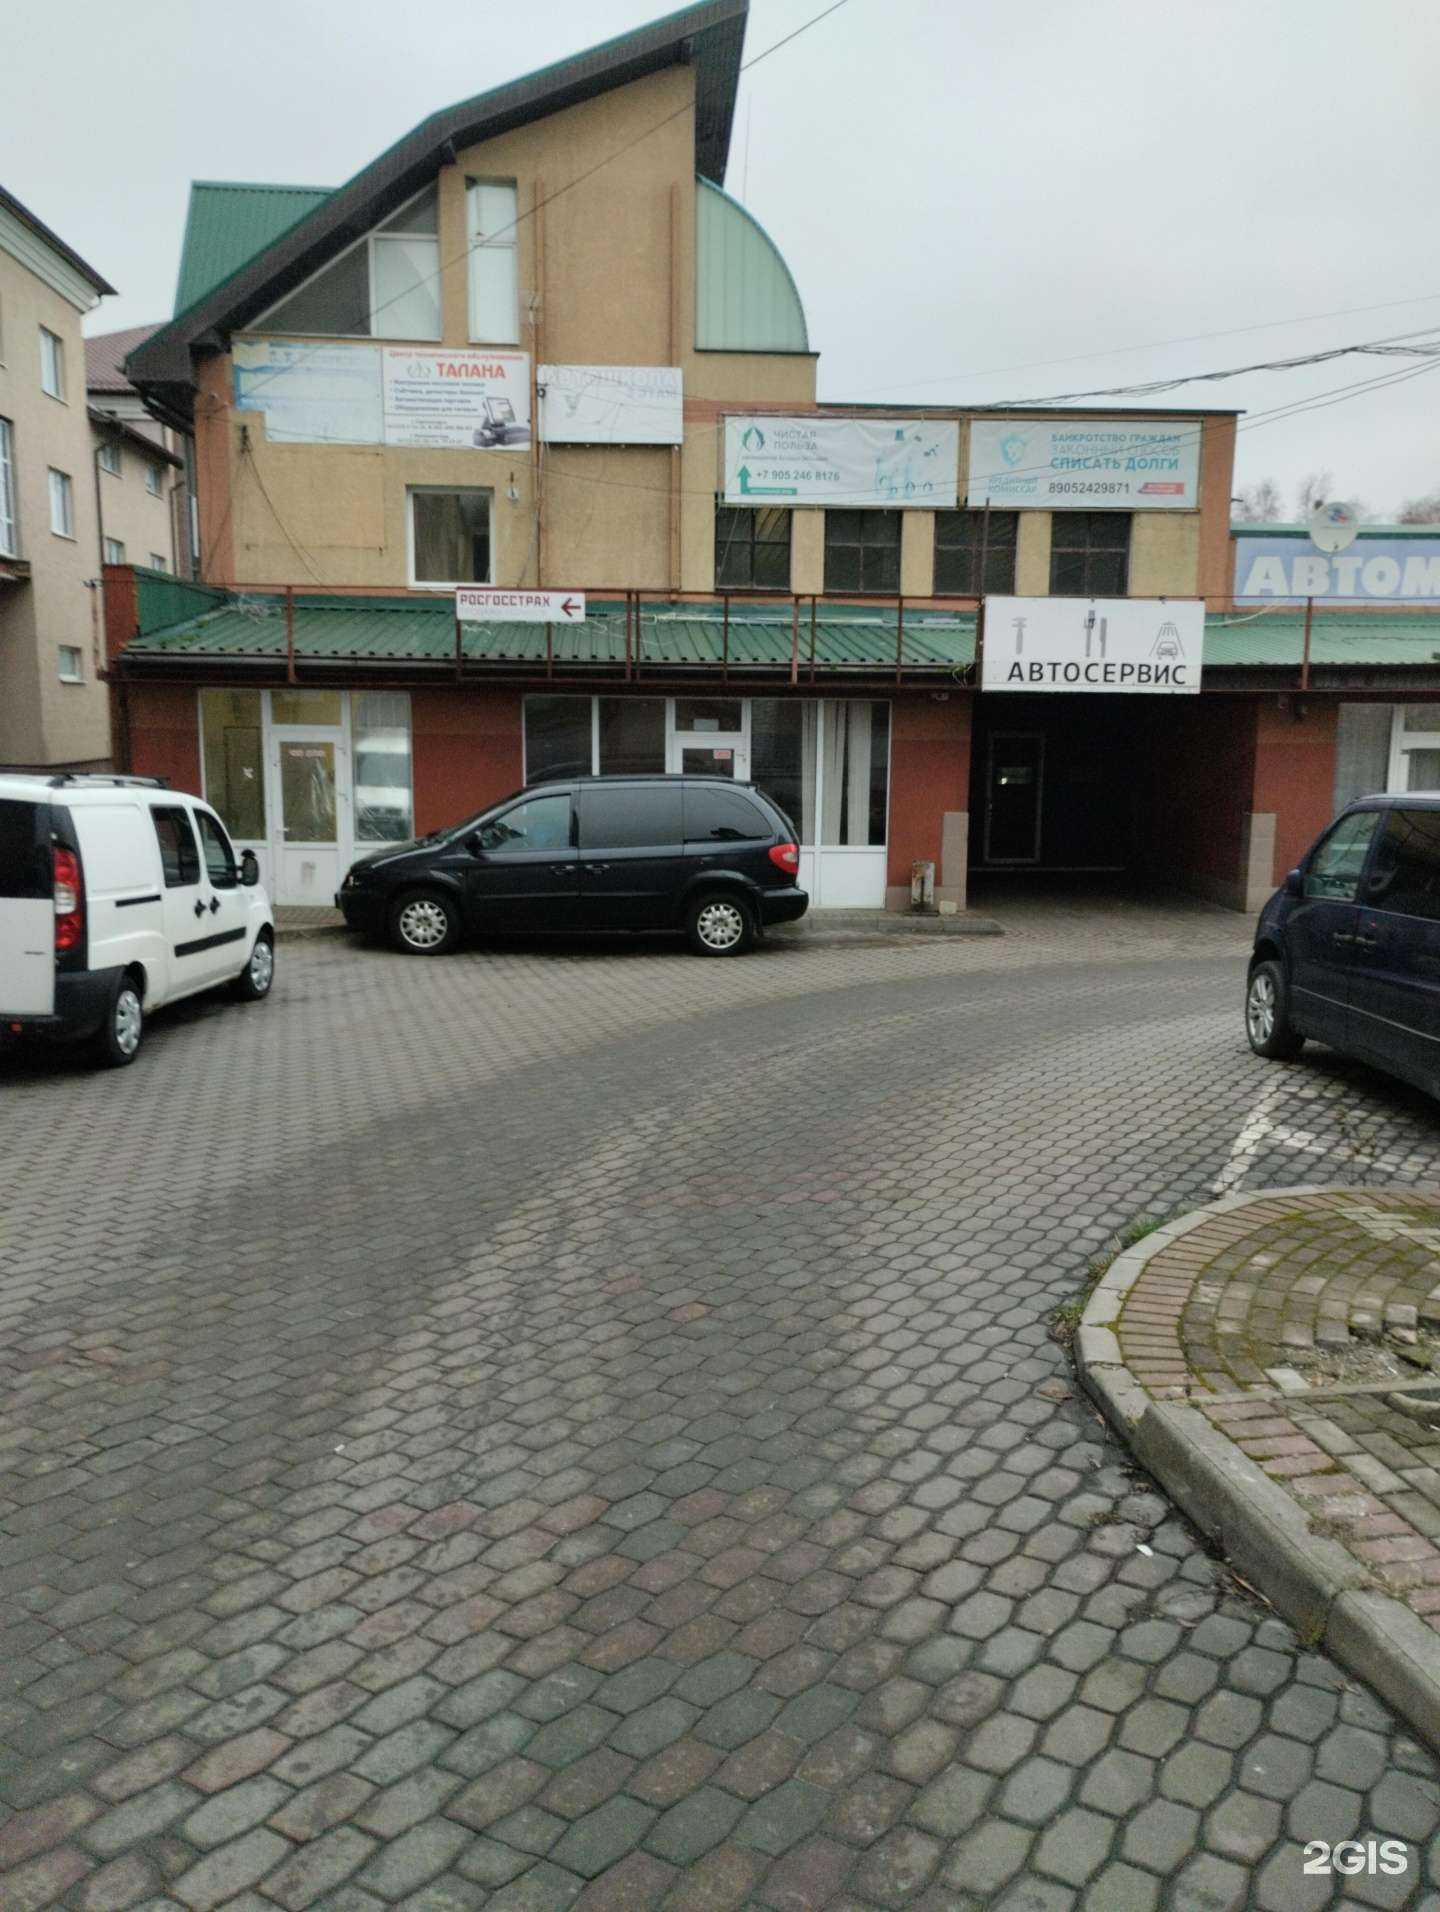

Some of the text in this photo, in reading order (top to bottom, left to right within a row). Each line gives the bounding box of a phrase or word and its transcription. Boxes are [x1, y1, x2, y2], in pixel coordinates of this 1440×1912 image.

[436, 362, 506, 379] ТАЛАНА
[1050, 457, 1179, 472] СПИСАТЬ ДОЛГИ
[757, 471, 769, 480] +7
[771, 470, 791, 480] 905
[793, 471, 813, 480] 246
[1049, 482, 1130, 494] 89052429871
[460, 594, 550, 607] РОСГОССТРАХ
[1008, 662, 1187, 685] АВТОСЕРВИС
